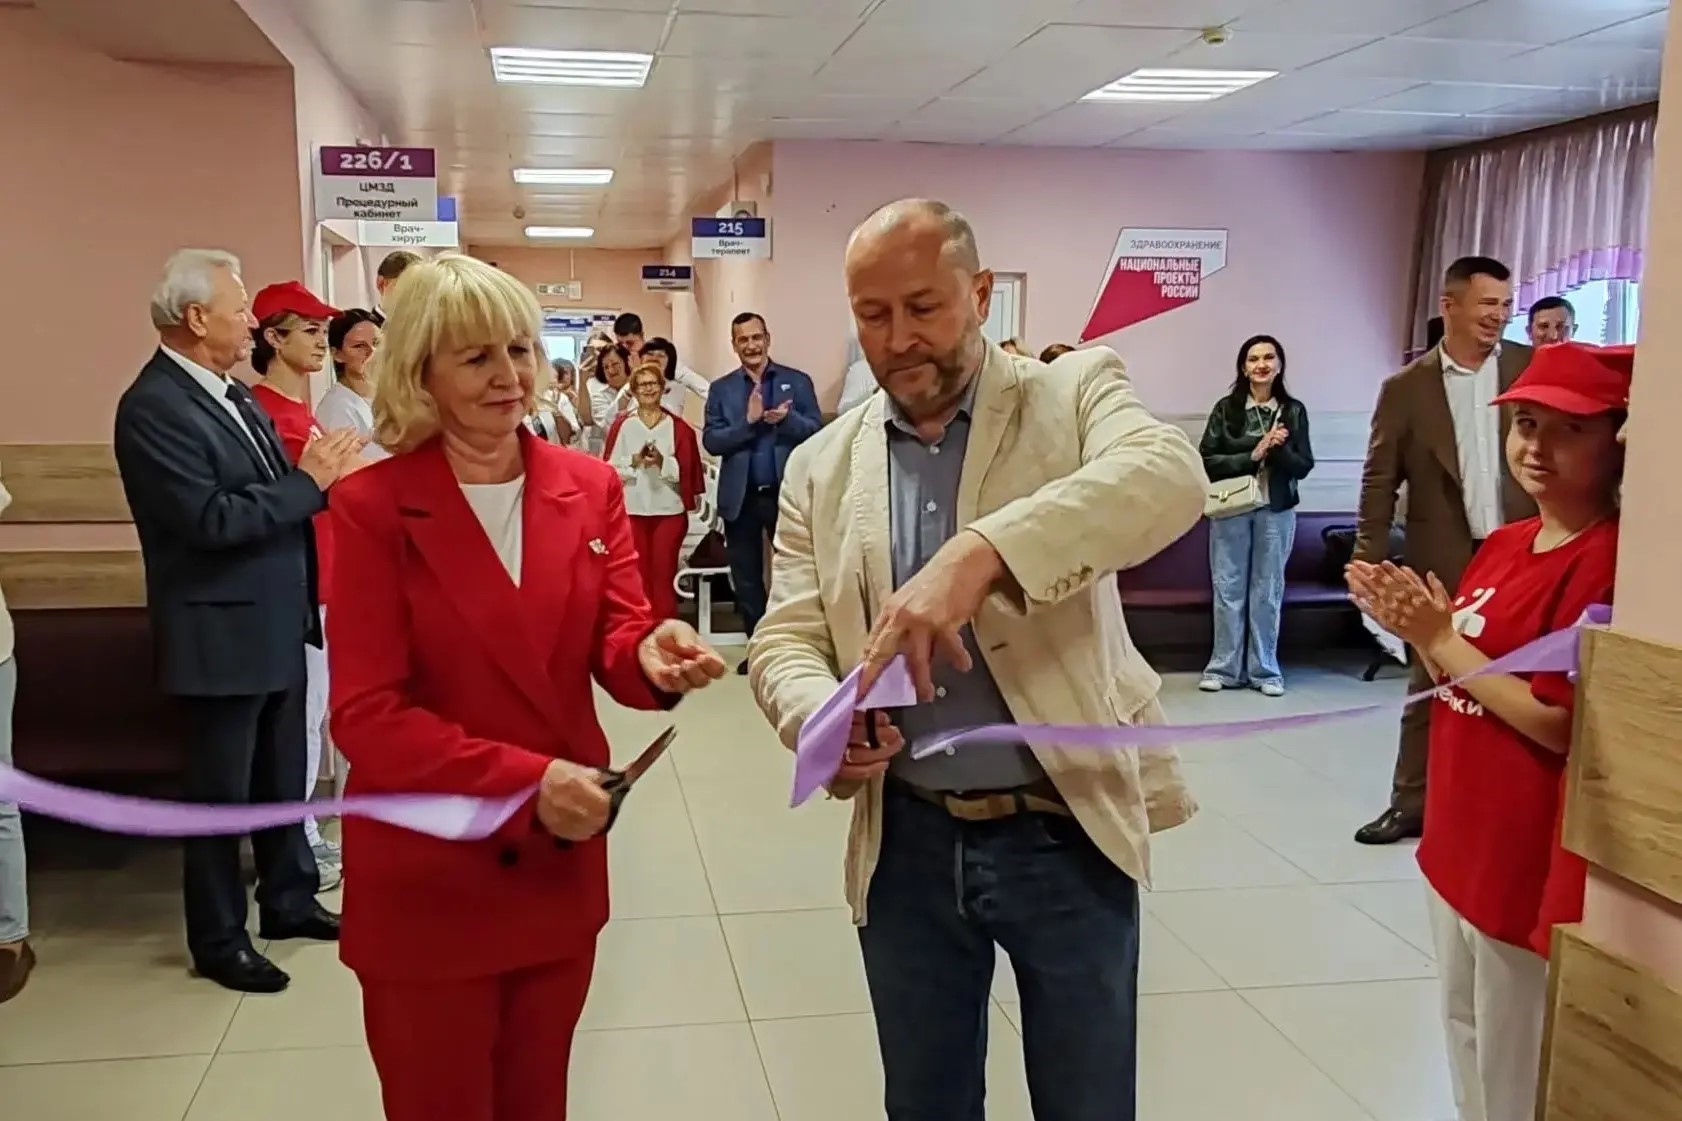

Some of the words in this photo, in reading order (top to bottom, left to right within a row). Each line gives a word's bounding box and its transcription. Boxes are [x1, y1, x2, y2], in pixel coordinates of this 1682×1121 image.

[340, 151, 413, 170] 226/1
[360, 182, 395, 193] ЦМЗД
[336, 197, 418, 209] Процедурный
[354, 210, 402, 219] кабинет
[394, 224, 424, 233] Врач-
[718, 222, 744, 236] 215
[391, 234, 426, 244] хирург
[718, 239, 743, 248] Врач-
[1130, 239, 1223, 250] ЗДРАВООХРАНЕНИЕ
[711, 247, 751, 257] терапевт
[1119, 258, 1199, 272] НАЦИОНАЛЬНЫЕ
[1153, 271, 1199, 285] ПРОЕКТЫ
[1161, 285, 1199, 298] РОССИИ
